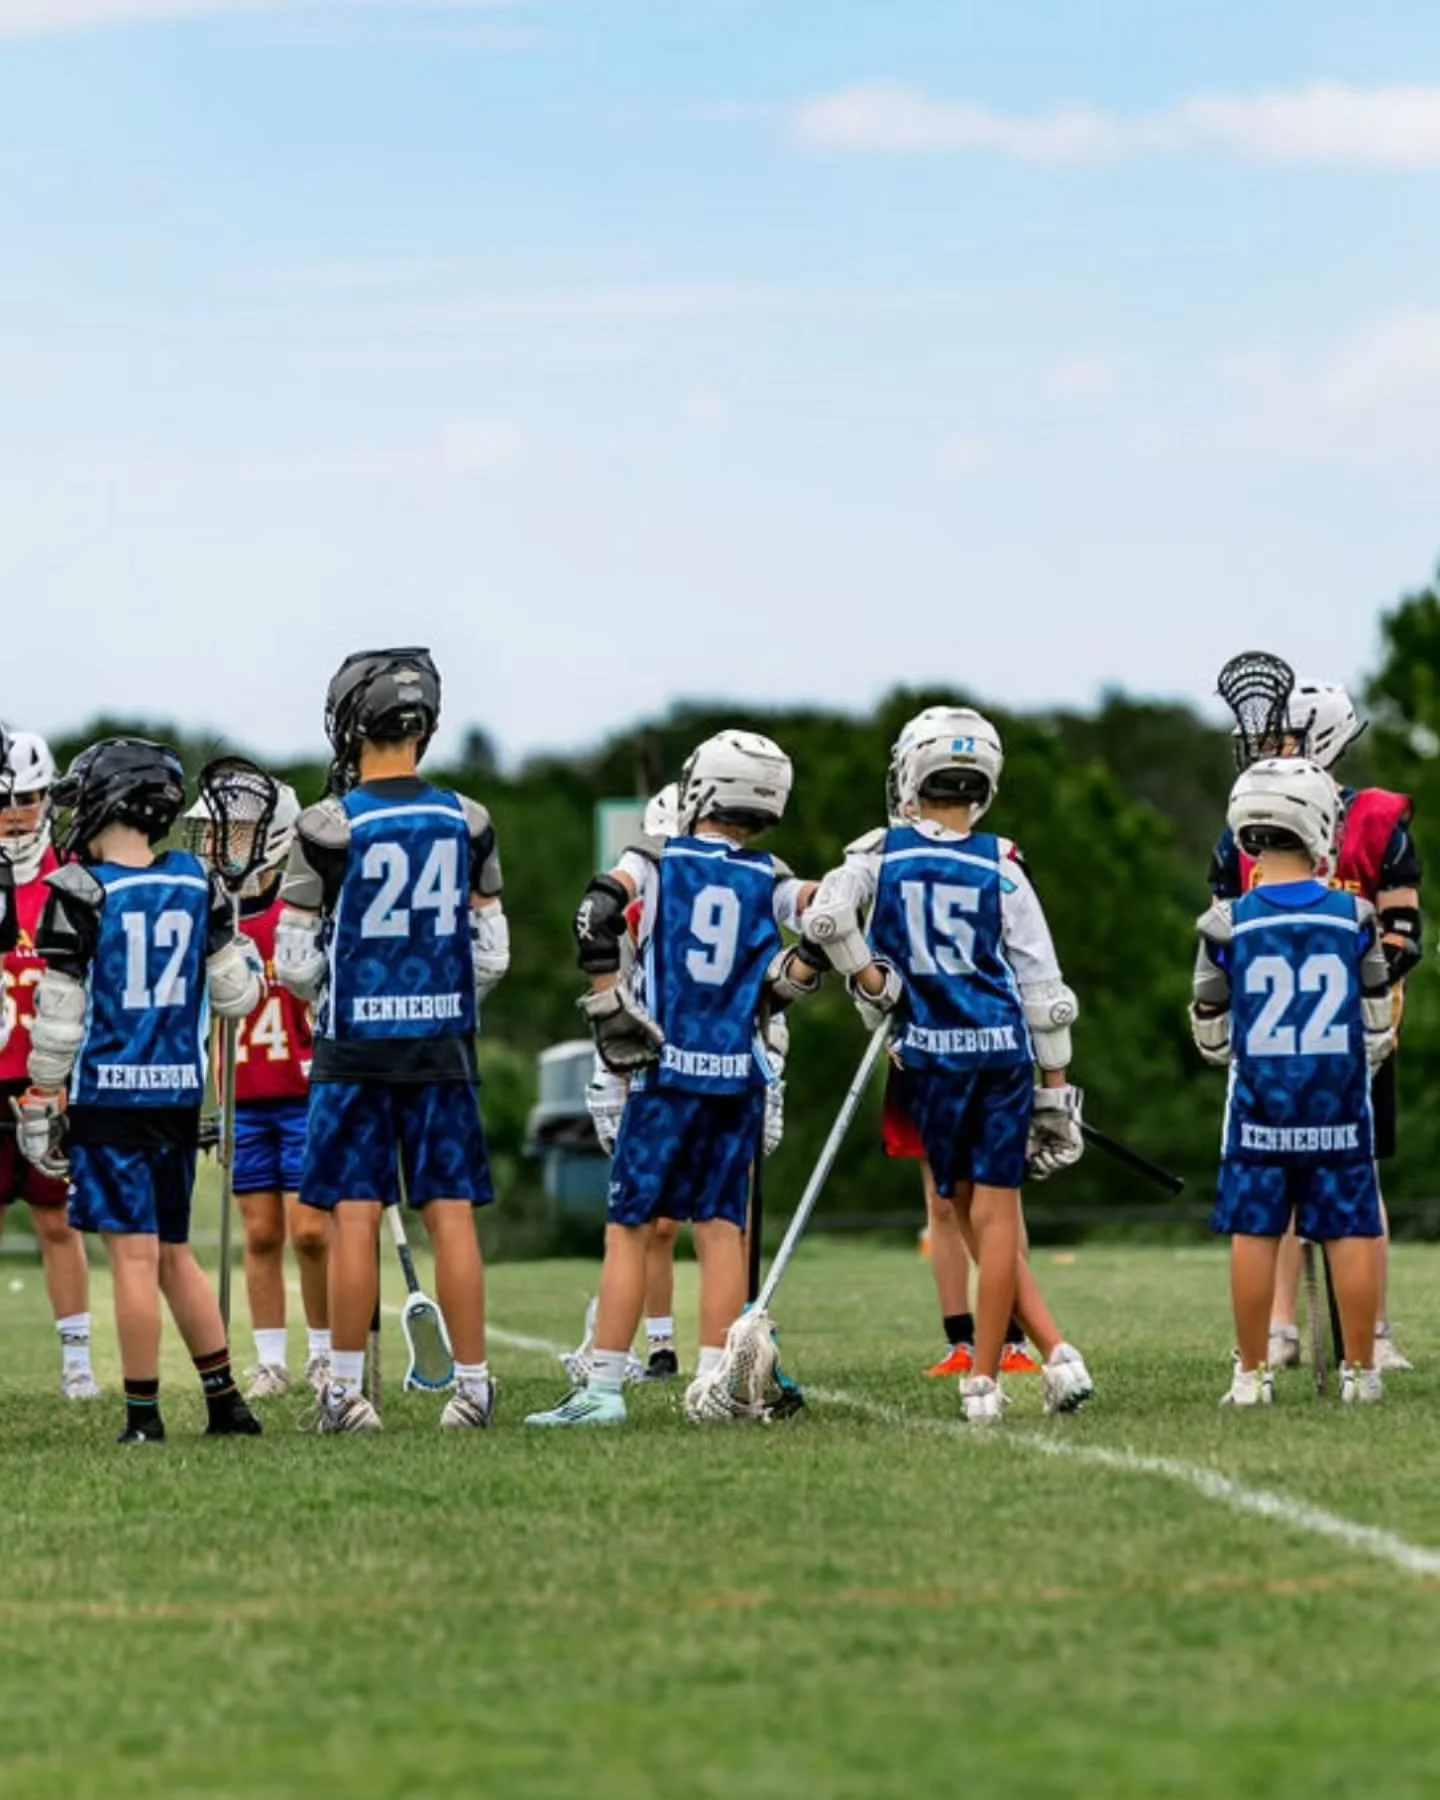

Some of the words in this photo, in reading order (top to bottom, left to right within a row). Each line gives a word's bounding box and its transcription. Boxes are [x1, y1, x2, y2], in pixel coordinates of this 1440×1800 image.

[361, 838, 461, 938] 24
[686, 885, 741, 985] 9
[901, 880, 980, 975] 15
[121, 909, 193, 1009] 12
[1246, 953, 1348, 1055] 22
[1241, 1122, 1359, 1152] KENNEBUNK
